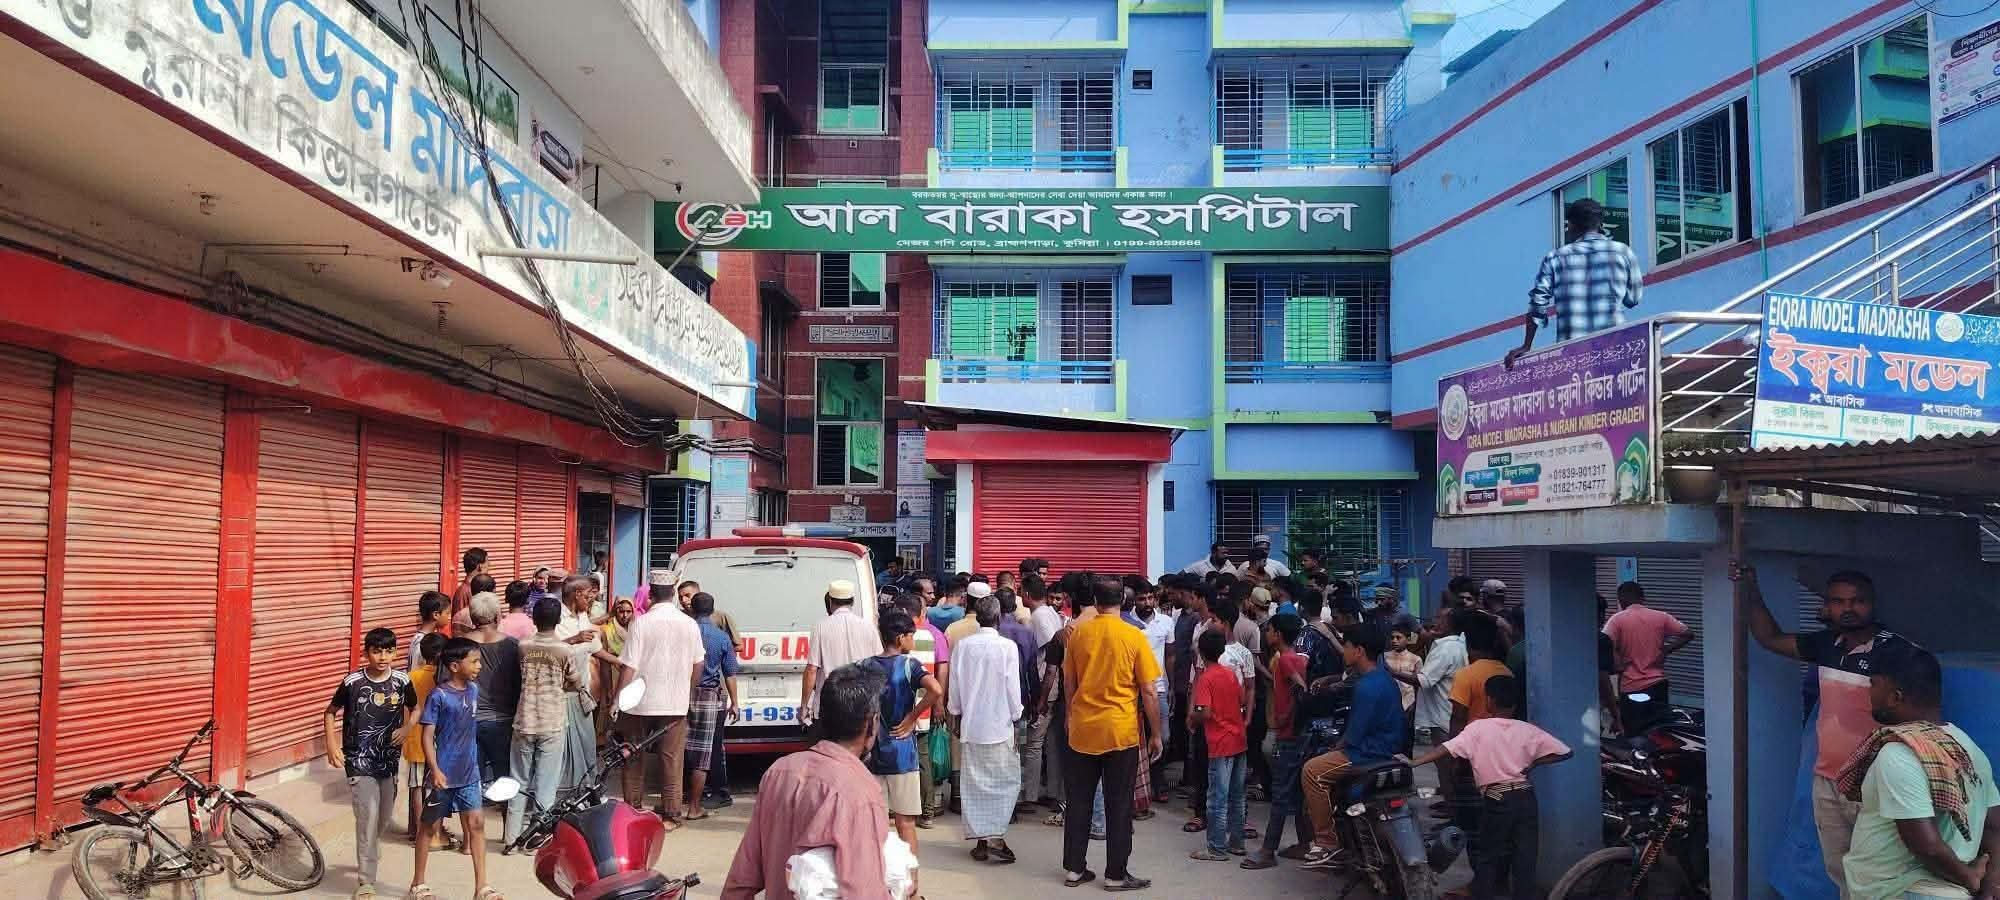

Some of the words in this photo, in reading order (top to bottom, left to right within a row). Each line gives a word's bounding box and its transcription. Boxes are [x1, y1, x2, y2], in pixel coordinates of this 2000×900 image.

[784, 201, 905, 234] আল
[918, 201, 1099, 235] বারাকা
[1112, 193, 1360, 237] হসপিটাল
[1769, 296, 1807, 328] EIQRA
[1810, 302, 1855, 334] MODEL
[1857, 306, 1930, 341] MADRASHA
[1879, 351, 1992, 400] মডেল
[1482, 430, 1504, 446] MODEL
[1504, 423, 1542, 442] MADRASHA
[1550, 417, 1578, 436] NURANI
[1609, 405, 1645, 427] GRADEN
